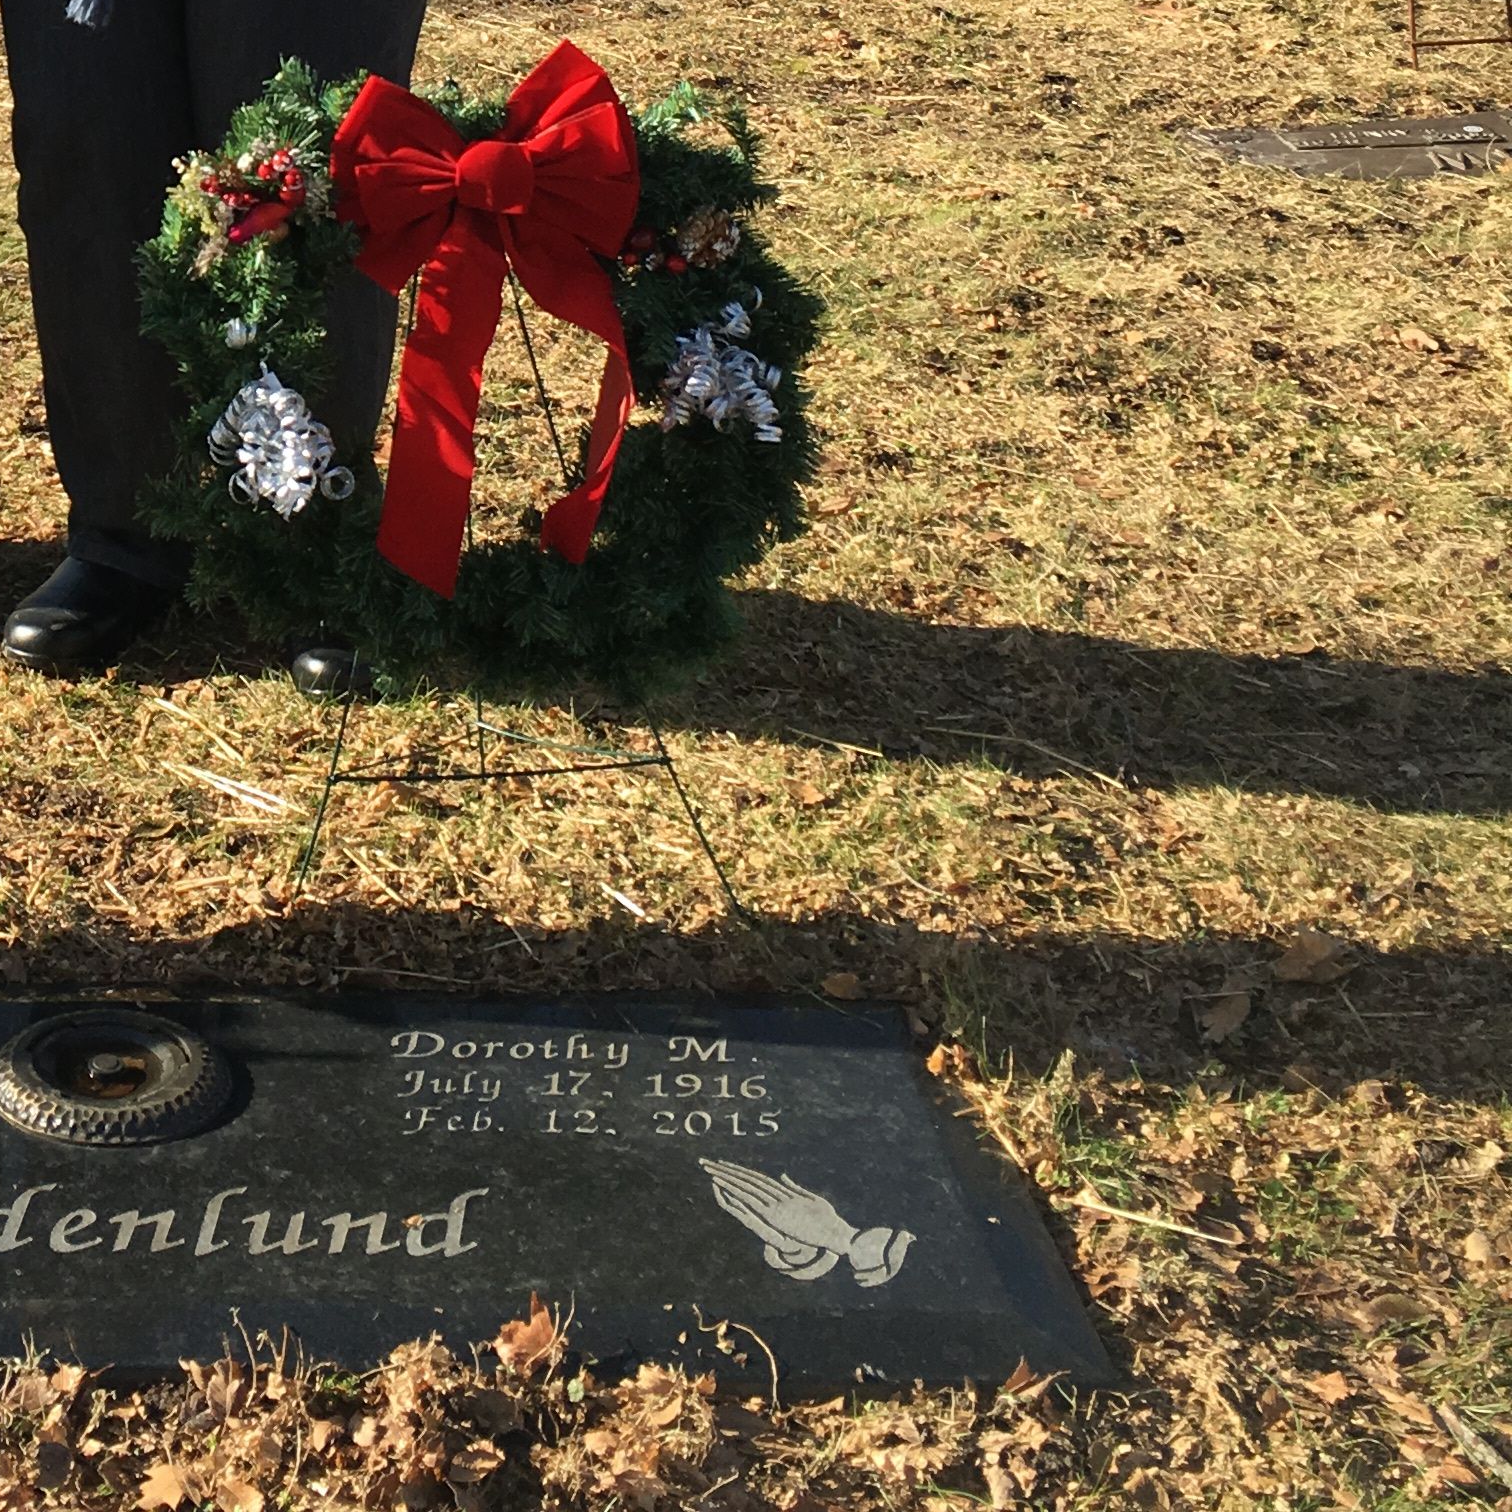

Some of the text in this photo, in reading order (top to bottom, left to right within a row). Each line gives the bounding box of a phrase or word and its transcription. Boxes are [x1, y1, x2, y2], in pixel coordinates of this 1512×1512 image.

[390, 1031, 758, 1069] Dorothy M.
[396, 1070, 767, 1102] July 17, 1916
[402, 1106, 782, 1137] Feb. 12, 2015
